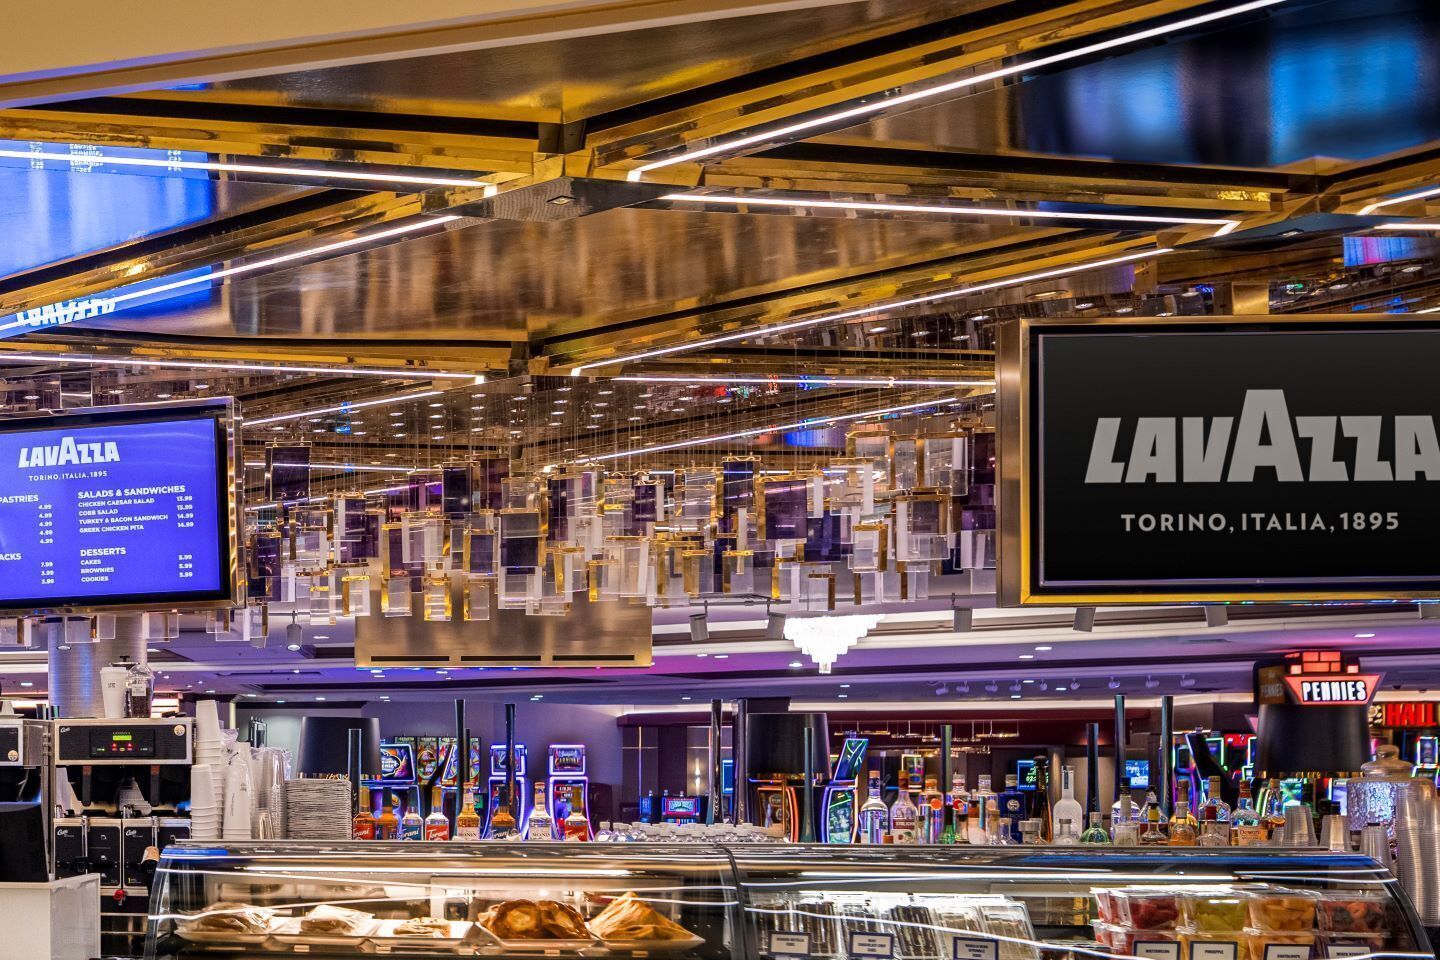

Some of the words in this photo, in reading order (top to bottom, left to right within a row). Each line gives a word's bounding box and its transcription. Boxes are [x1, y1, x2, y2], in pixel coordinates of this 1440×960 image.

[1084, 389, 1440, 483] LAVAZZA
[18, 437, 121, 468] LAVAZZA
[78, 490, 114, 499] SALADS
[124, 485, 186, 496] SANDWICHES
[1121, 513, 1234, 533] TORINO,
[1242, 512, 1335, 532] ITALIA,
[1340, 512, 1399, 530] 1895
[80, 548, 126, 557] DESSERTS
[1302, 681, 1366, 701] PENNIES
[1387, 703, 1437, 726] HALL
